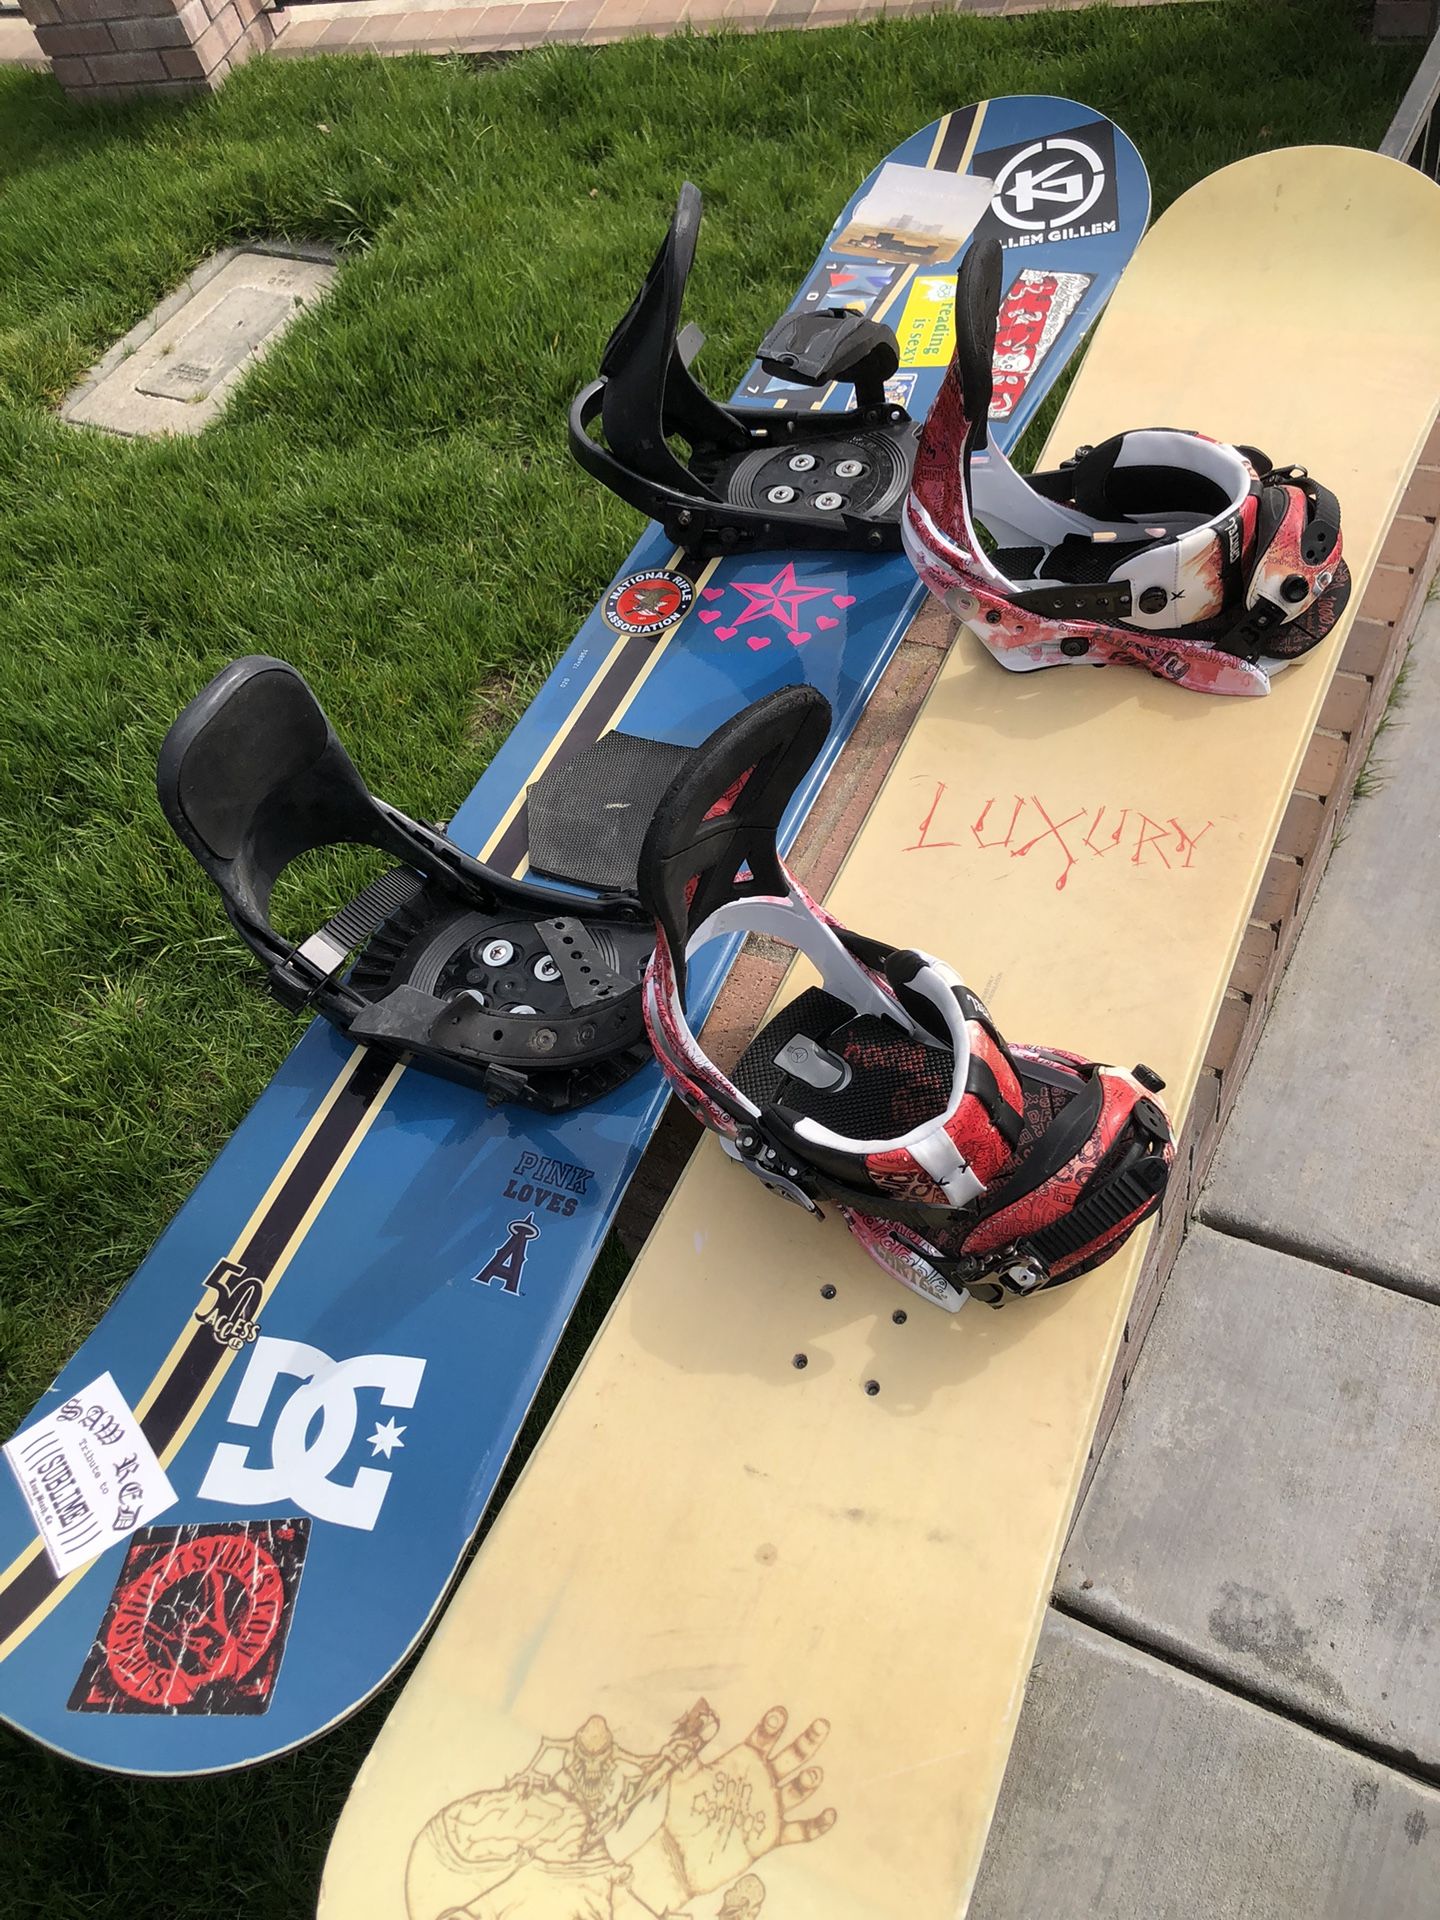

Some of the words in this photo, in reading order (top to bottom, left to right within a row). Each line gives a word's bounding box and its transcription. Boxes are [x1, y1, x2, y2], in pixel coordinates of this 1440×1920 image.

[998, 233, 1044, 249] LLEM
[1048, 220, 1116, 242] GILLEM
[913, 318, 931, 329] is
[923, 302, 953, 354] reading
[900, 333, 921, 364] sexy
[609, 571, 670, 600] NATIONAL
[672, 575, 692, 601] RIFLE
[606, 611, 681, 633] ASSOCIATION
[902, 781, 1215, 890] LUXURY
[513, 1151, 595, 1195] PINK
[502, 1179, 579, 1217] LOVES
[204, 1307, 260, 1342] ACCESS
[56, 1398, 126, 1446] SAW
[198, 1335, 428, 1531] DC
[78, 1437, 101, 1479] Tribute
[98, 1481, 110, 1495] to
